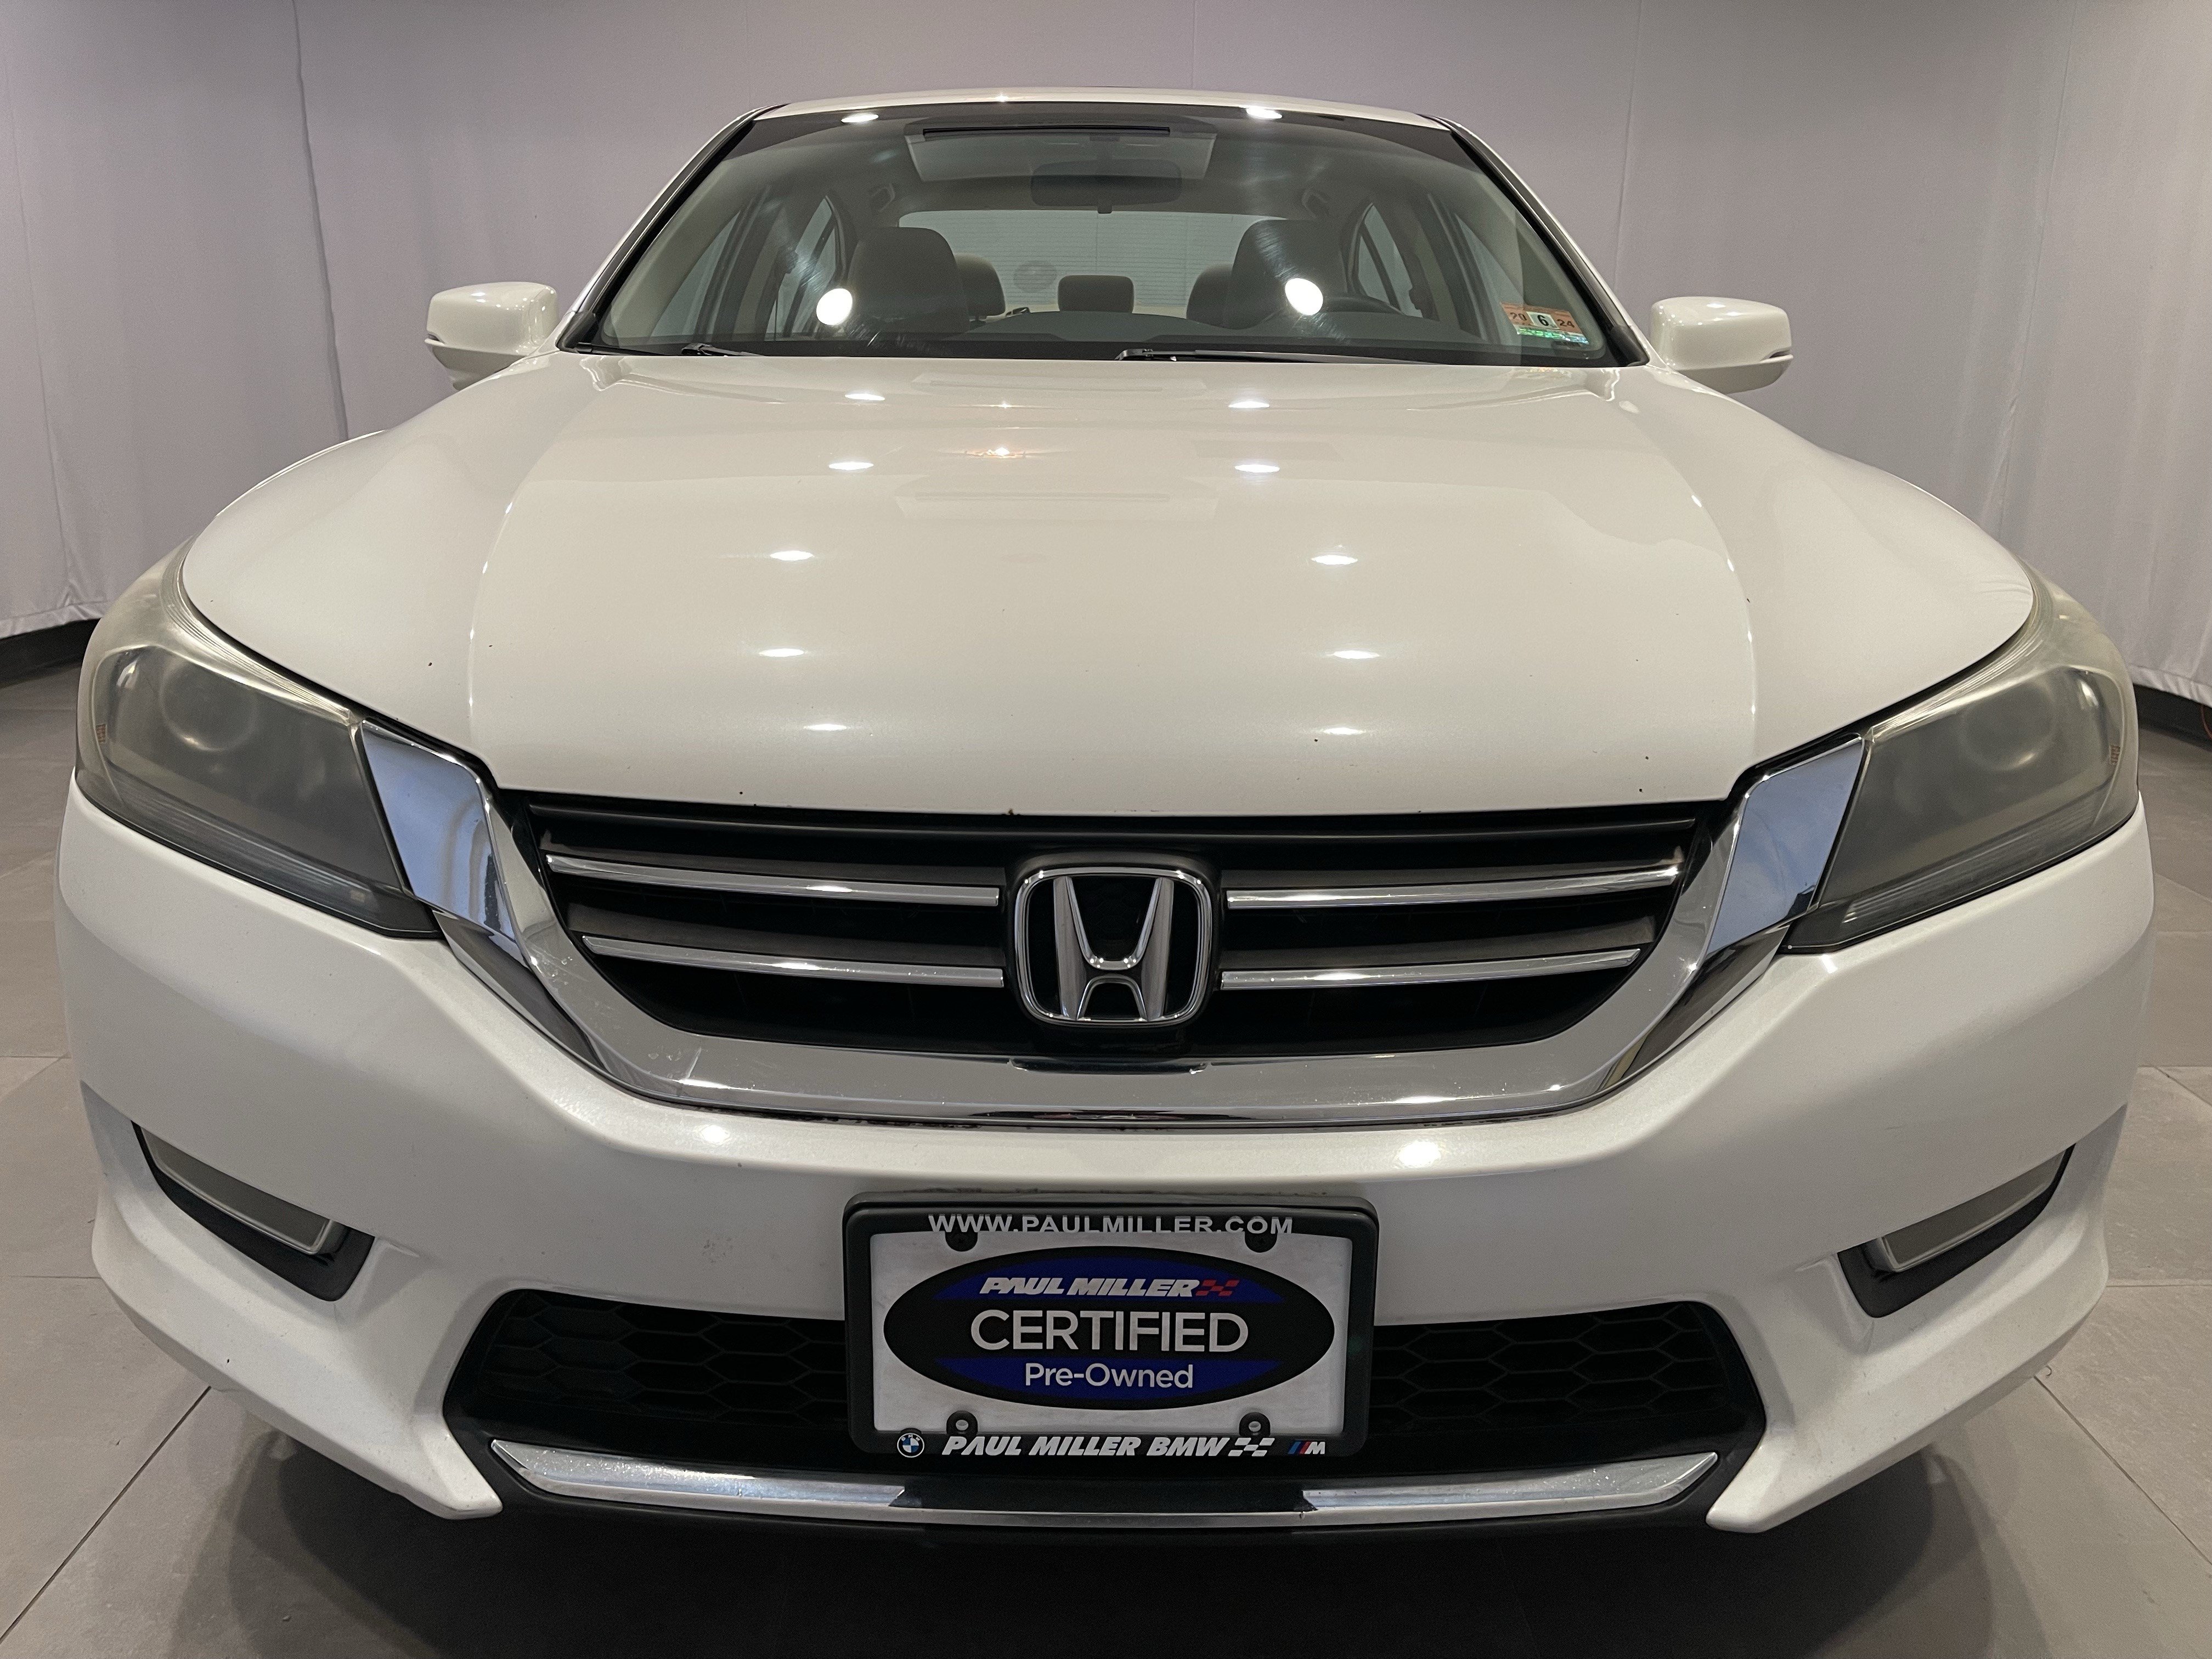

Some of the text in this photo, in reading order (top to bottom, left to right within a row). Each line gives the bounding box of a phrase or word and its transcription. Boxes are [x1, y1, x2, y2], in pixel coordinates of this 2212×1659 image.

[1537, 314, 1549, 326] 6
[1557, 319, 1575, 328] 24
[928, 1214, 1293, 1234] WWW.PAULMILLER.COM
[979, 1277, 1200, 1297] PAUL MILLER
[970, 1309, 1249, 1353] CERTIFIED
[1024, 1362, 1194, 1389] Pre-Owned
[941, 1435, 1231, 1457] PAUL MILLER BMW
